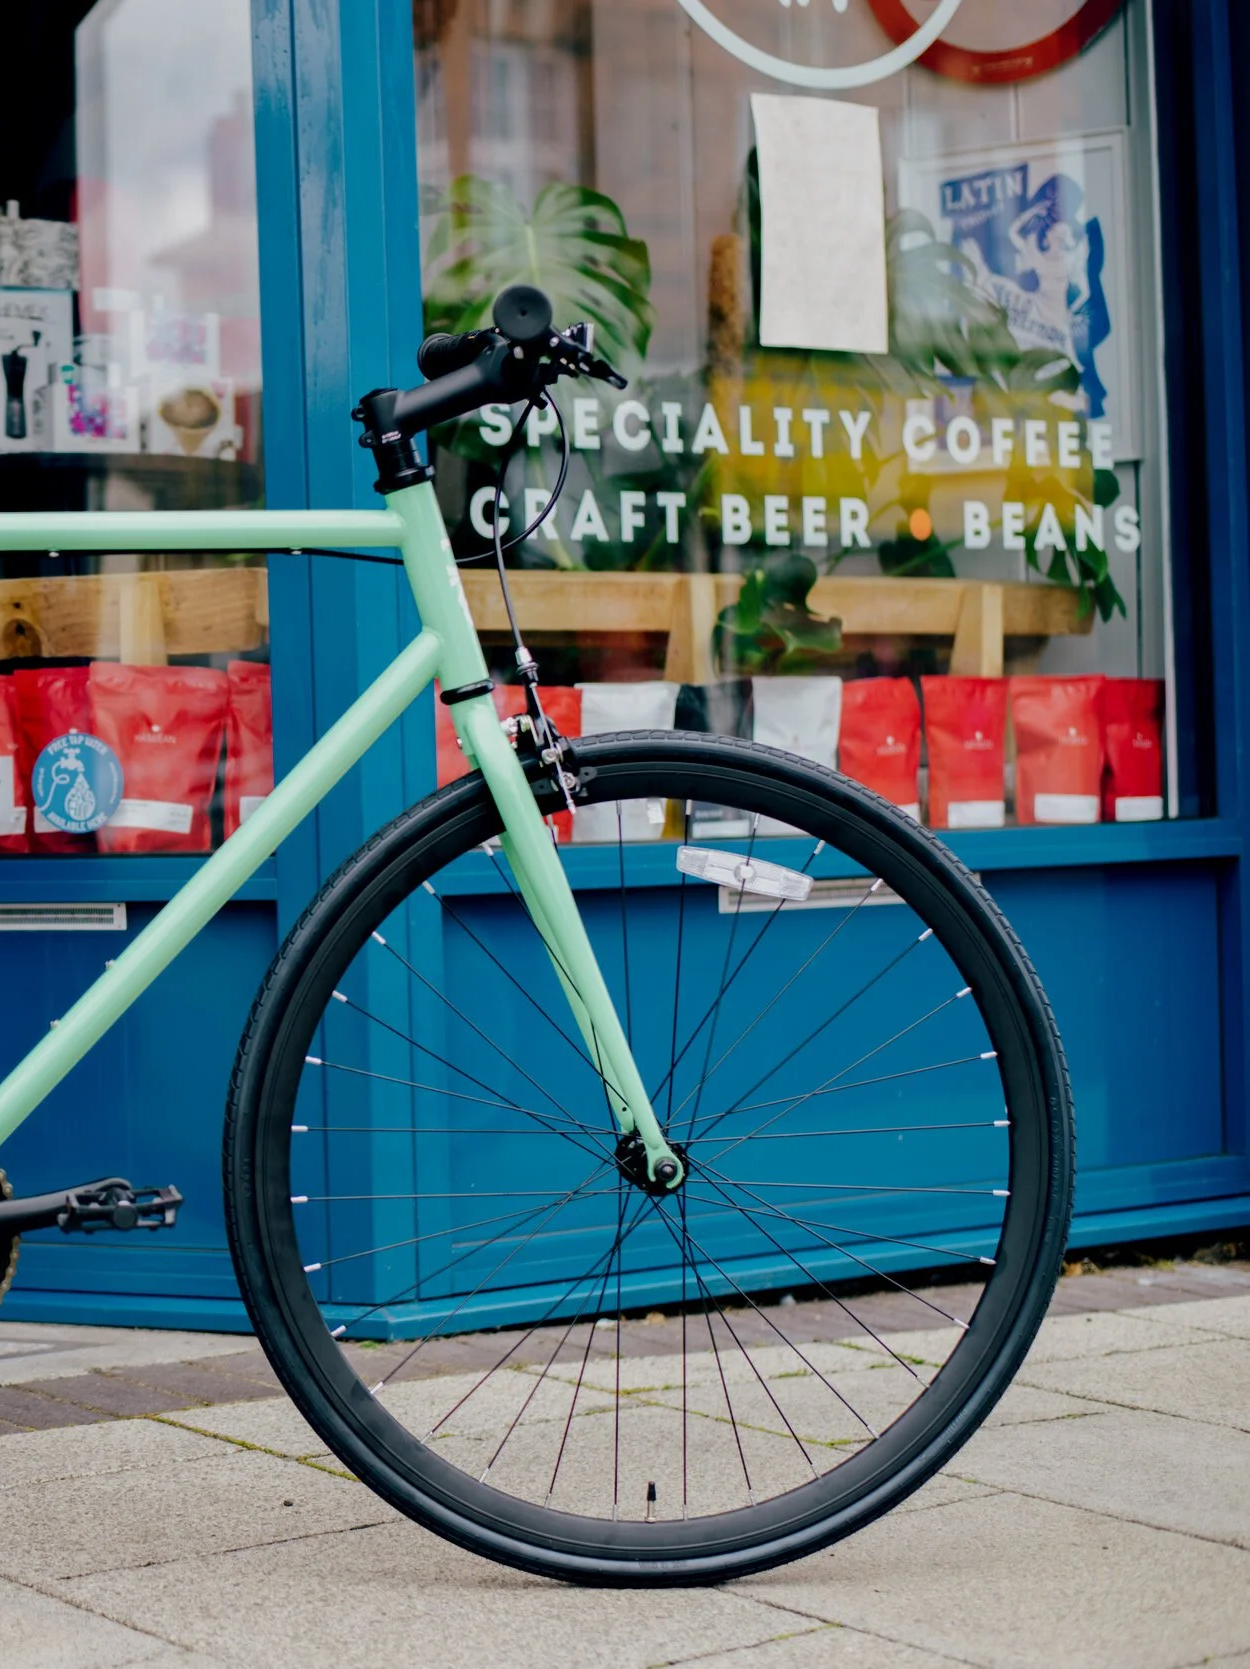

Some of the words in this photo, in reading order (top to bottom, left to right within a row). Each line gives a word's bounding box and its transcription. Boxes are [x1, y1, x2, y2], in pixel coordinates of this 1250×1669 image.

[945, 170, 1024, 210] LATIN
[479, 397, 872, 460] SPECIALITY
[903, 415, 1115, 471] COFFEE
[469, 486, 687, 544] CRAFT
[721, 493, 872, 548] BEER
[963, 500, 1142, 553] BEANS
